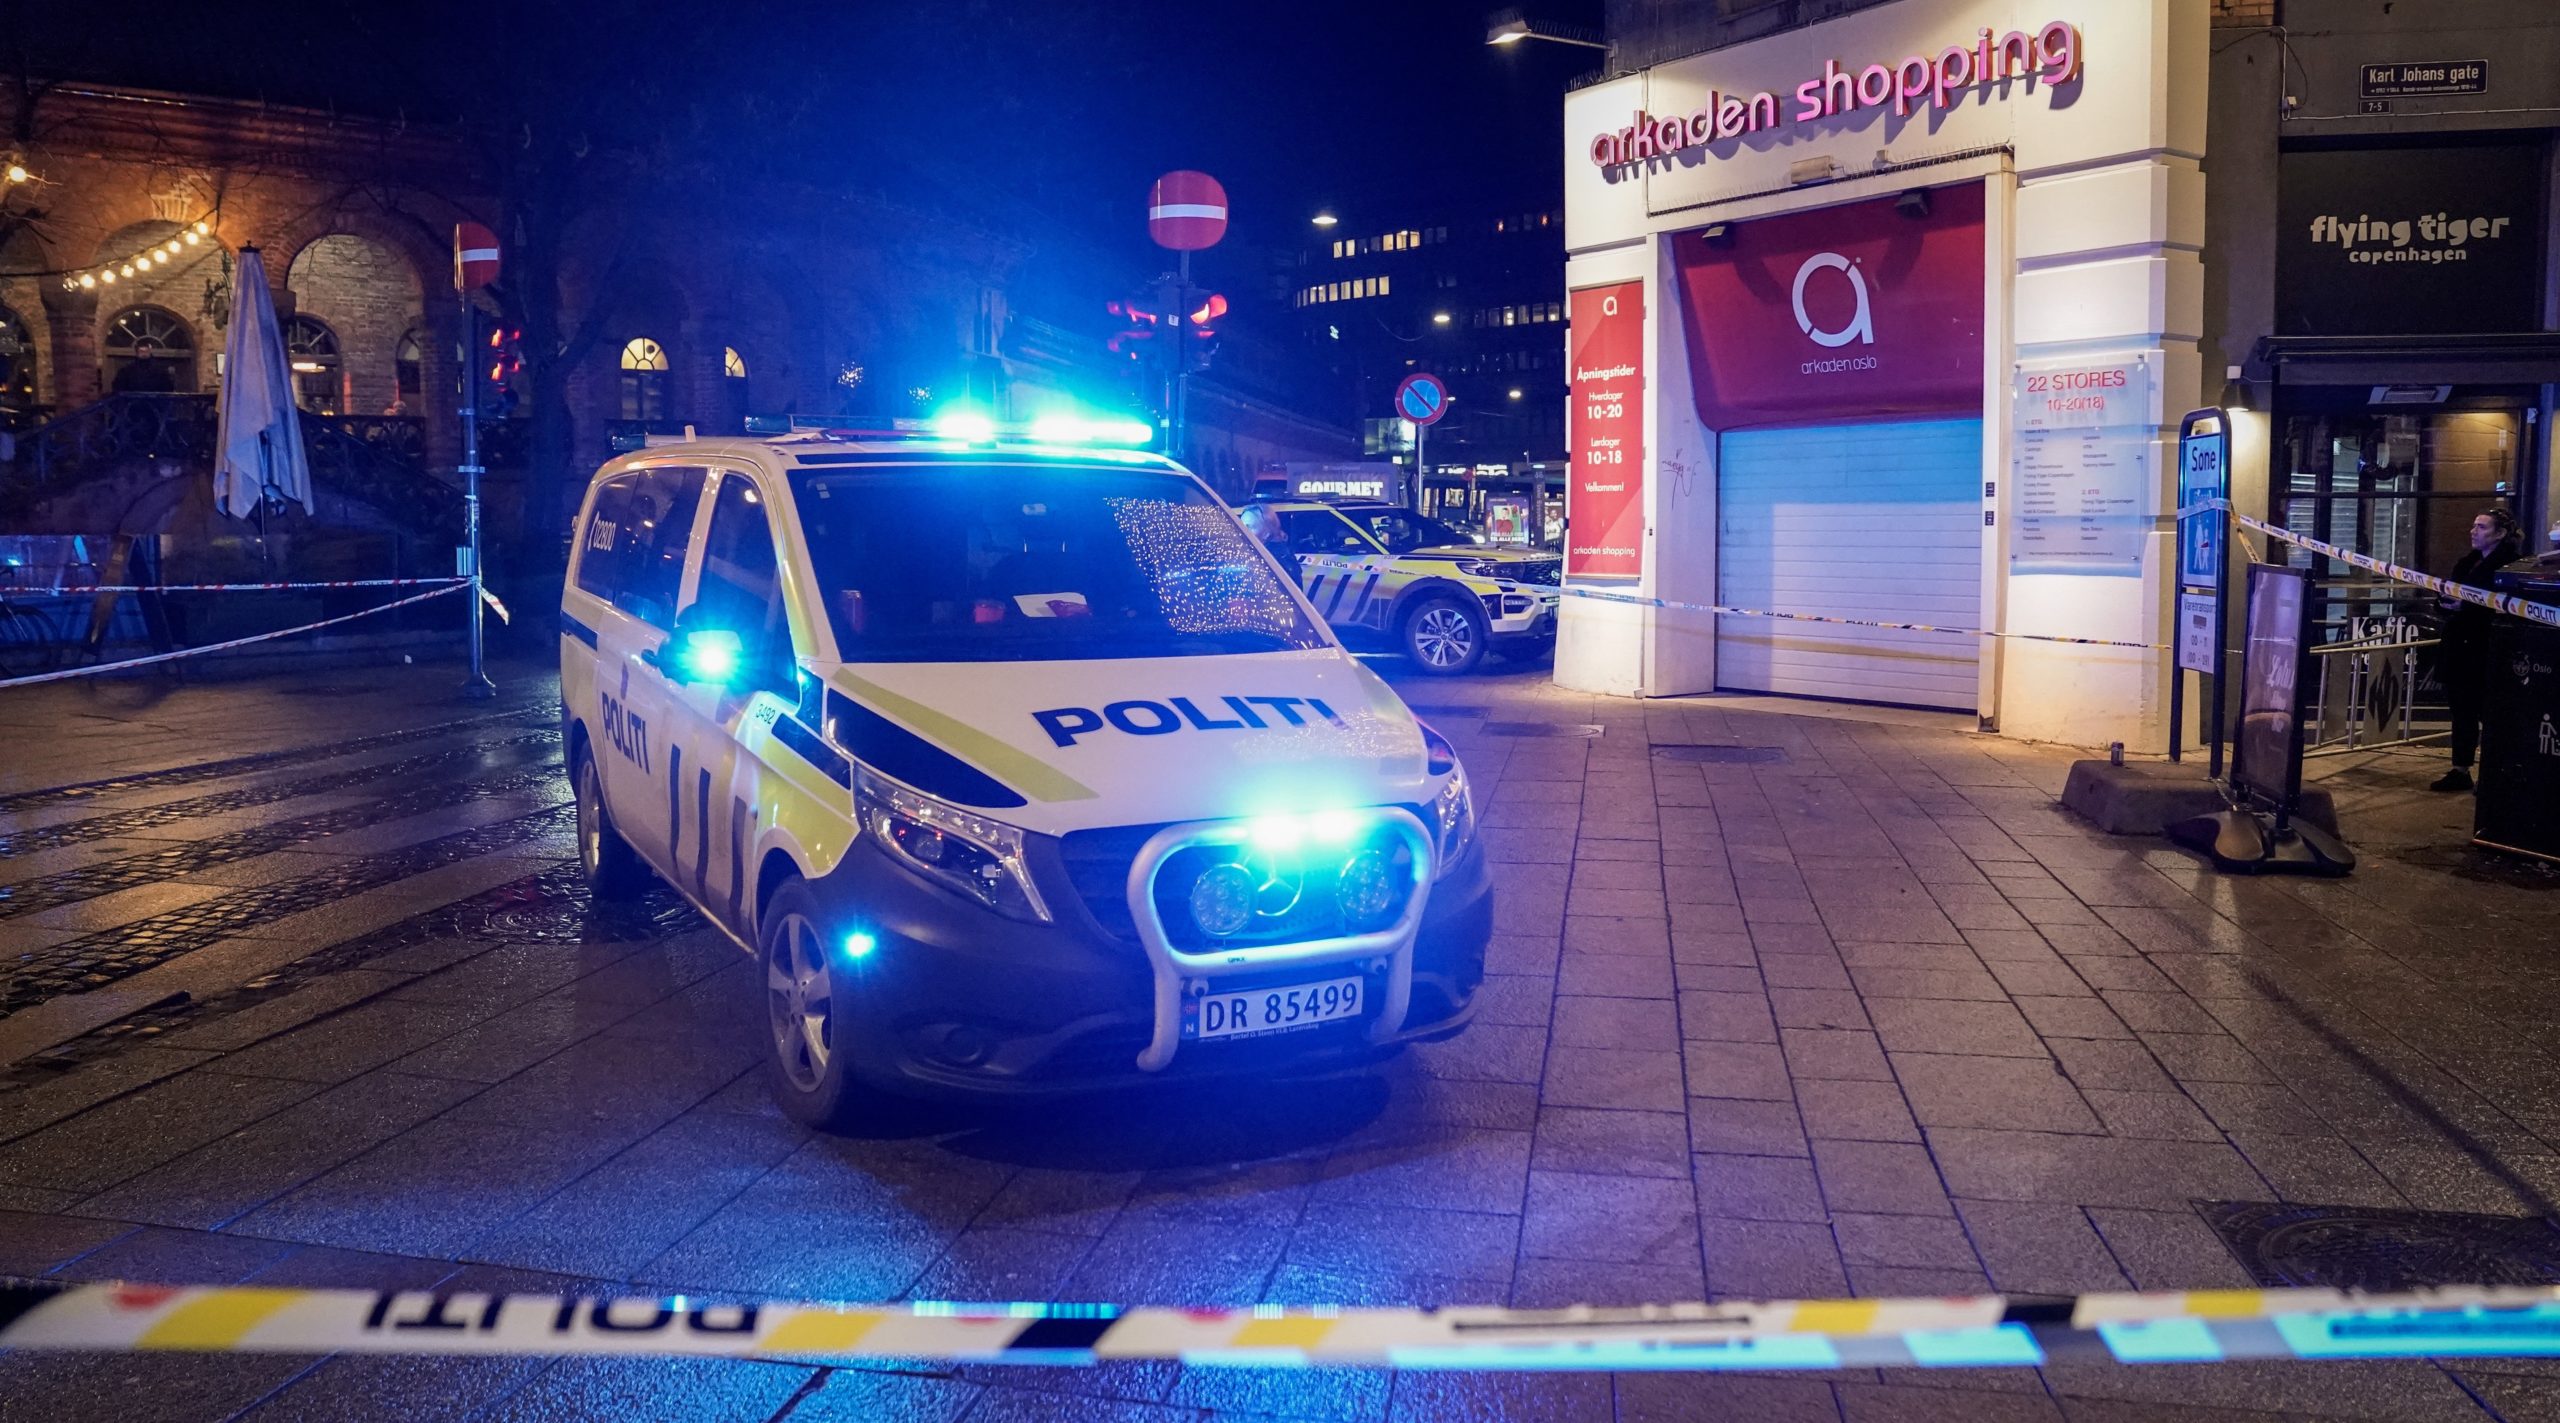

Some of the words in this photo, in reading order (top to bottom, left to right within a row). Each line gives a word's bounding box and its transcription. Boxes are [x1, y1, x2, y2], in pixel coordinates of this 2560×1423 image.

[2369, 67, 2395, 83] Karl
[2401, 67, 2445, 82] Johans
[2450, 65, 2479, 84] gate
[1590, 90, 1780, 168] arkaden
[1796, 20, 2082, 122] shopping
[2368, 102, 2382, 112] 7-5
[2310, 214, 2411, 249] flying
[2418, 212, 2510, 246] tiger
[2349, 248, 2467, 265] copenhagen
[1577, 364, 1636, 383] Åpningstider
[2027, 376, 2048, 392] 22
[2052, 369, 2126, 391] STORES
[1588, 390, 1624, 402] Hverdager
[1587, 403, 1623, 419] 10-20
[1587, 450, 1622, 464] 10-18
[2191, 446, 2216, 471] Sone
[1299, 481, 1384, 496] GOURMET
[1584, 483, 1624, 492] Velkommen!
[593, 520, 617, 551] 02800
[1573, 546, 1600, 555] arkaden
[1602, 546, 1635, 556] shopping
[1323, 560, 1348, 569] POLITI
[2402, 570, 2425, 586] POLITI
[2527, 604, 2557, 623] POLITI
[2351, 616, 2419, 647] Kaffe
[2533, 663, 2552, 674] Oslo
[756, 703, 776, 725] 3492
[1031, 696, 1352, 748] POLITI
[602, 691, 650, 775] POLITI
[1206, 998, 1247, 1032] DR
[1264, 982, 1357, 1024] 85499
[1185, 1023, 1194, 1032] N
